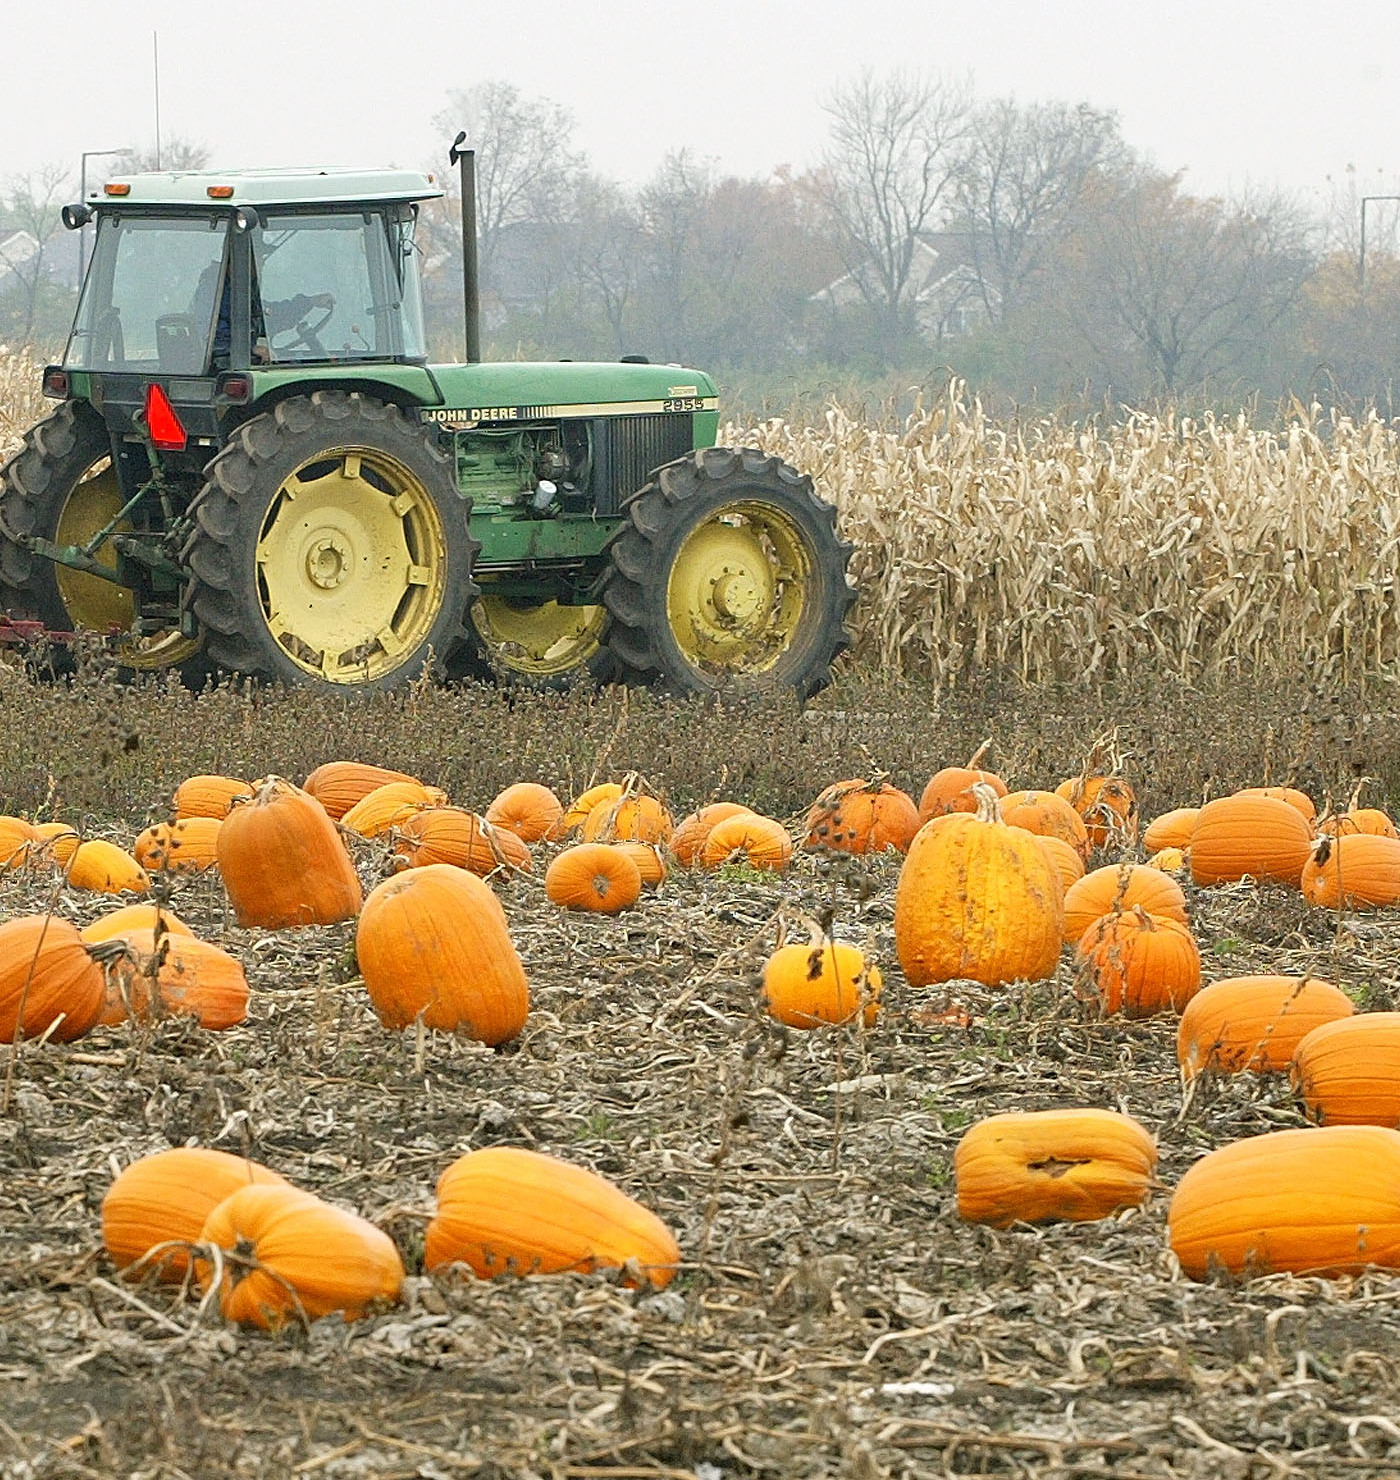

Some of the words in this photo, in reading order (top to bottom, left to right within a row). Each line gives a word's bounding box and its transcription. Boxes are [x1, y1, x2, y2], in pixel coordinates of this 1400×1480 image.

[663, 399, 704, 411] 2955
[429, 410, 467, 422] JOHN
[471, 408, 517, 420] DEERE
